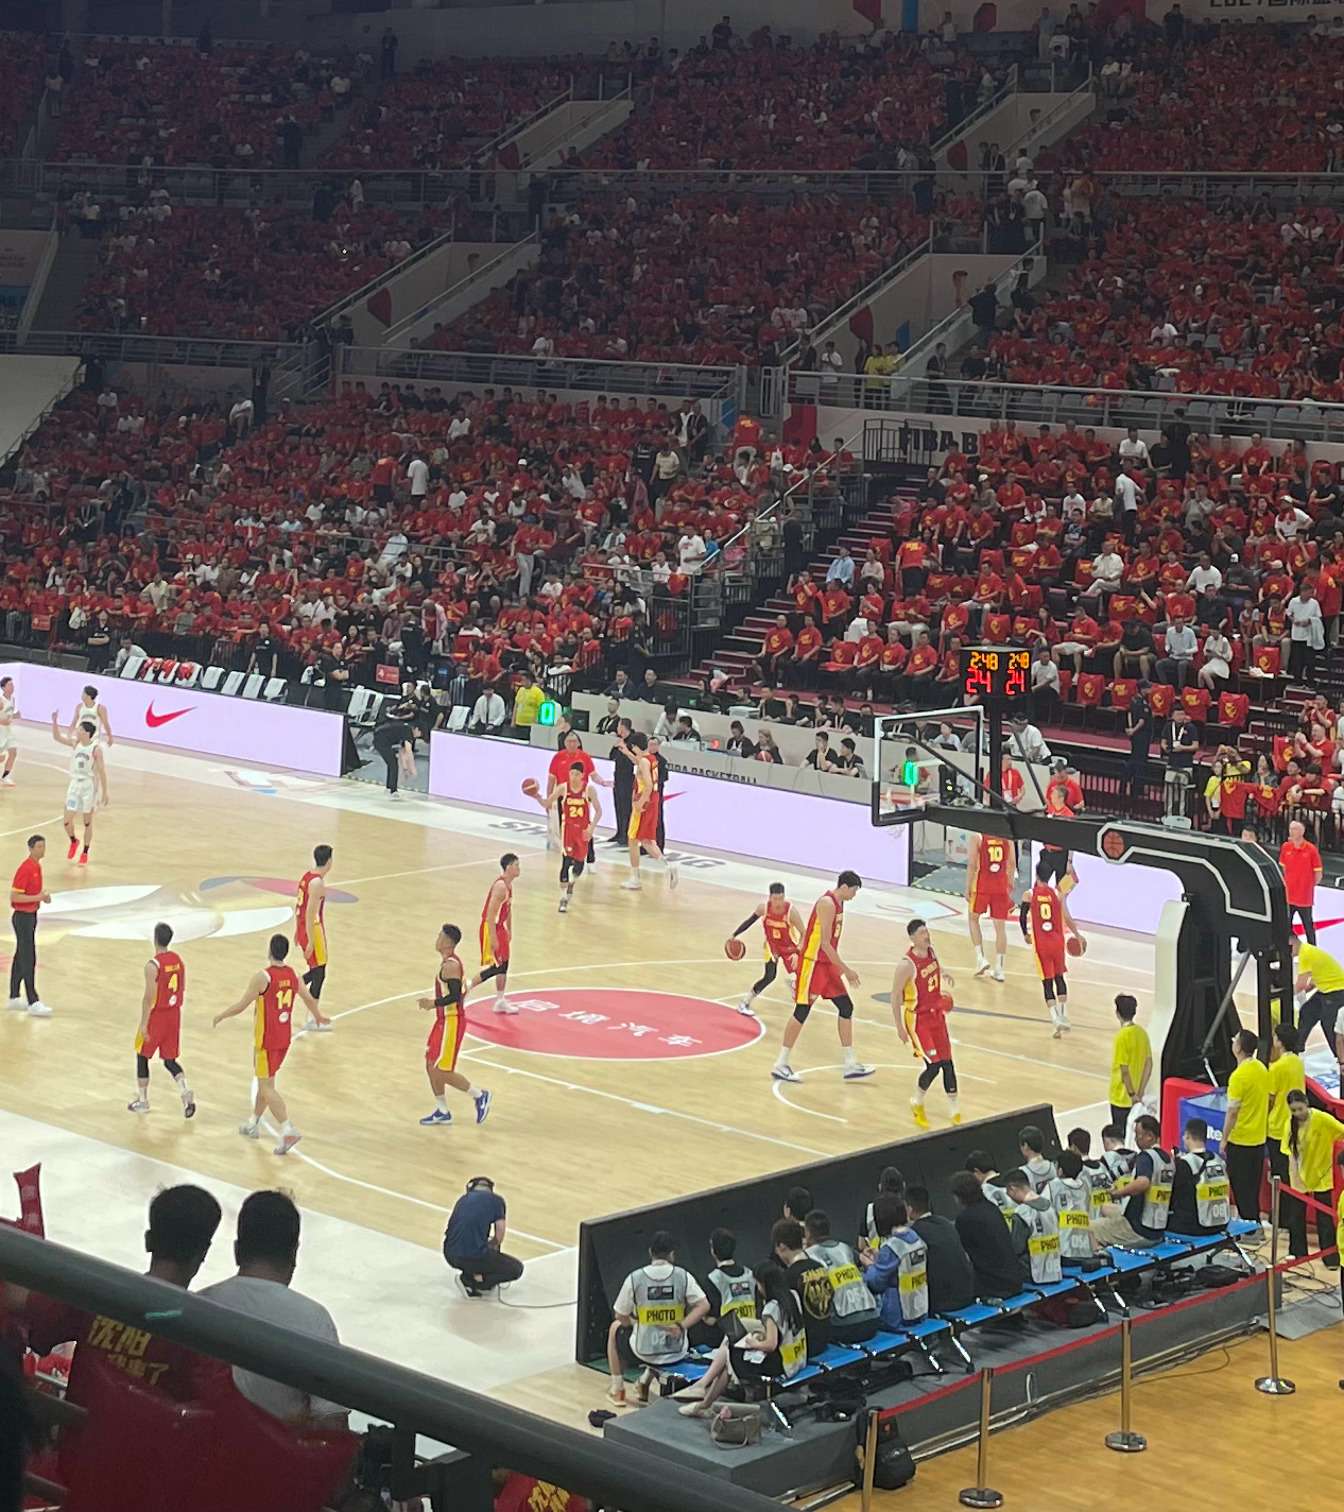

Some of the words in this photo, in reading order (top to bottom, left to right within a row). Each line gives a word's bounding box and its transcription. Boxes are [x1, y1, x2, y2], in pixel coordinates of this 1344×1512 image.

[965, 666, 993, 694] 24
[1005, 668, 1027, 696] 24
[569, 806, 584, 818] 24
[988, 846, 1003, 862] 10
[1040, 903, 1052, 920] 0
[168, 972, 178, 992] 4
[276, 988, 293, 1009] 14
[646, 1308, 676, 1322] PHOTO
